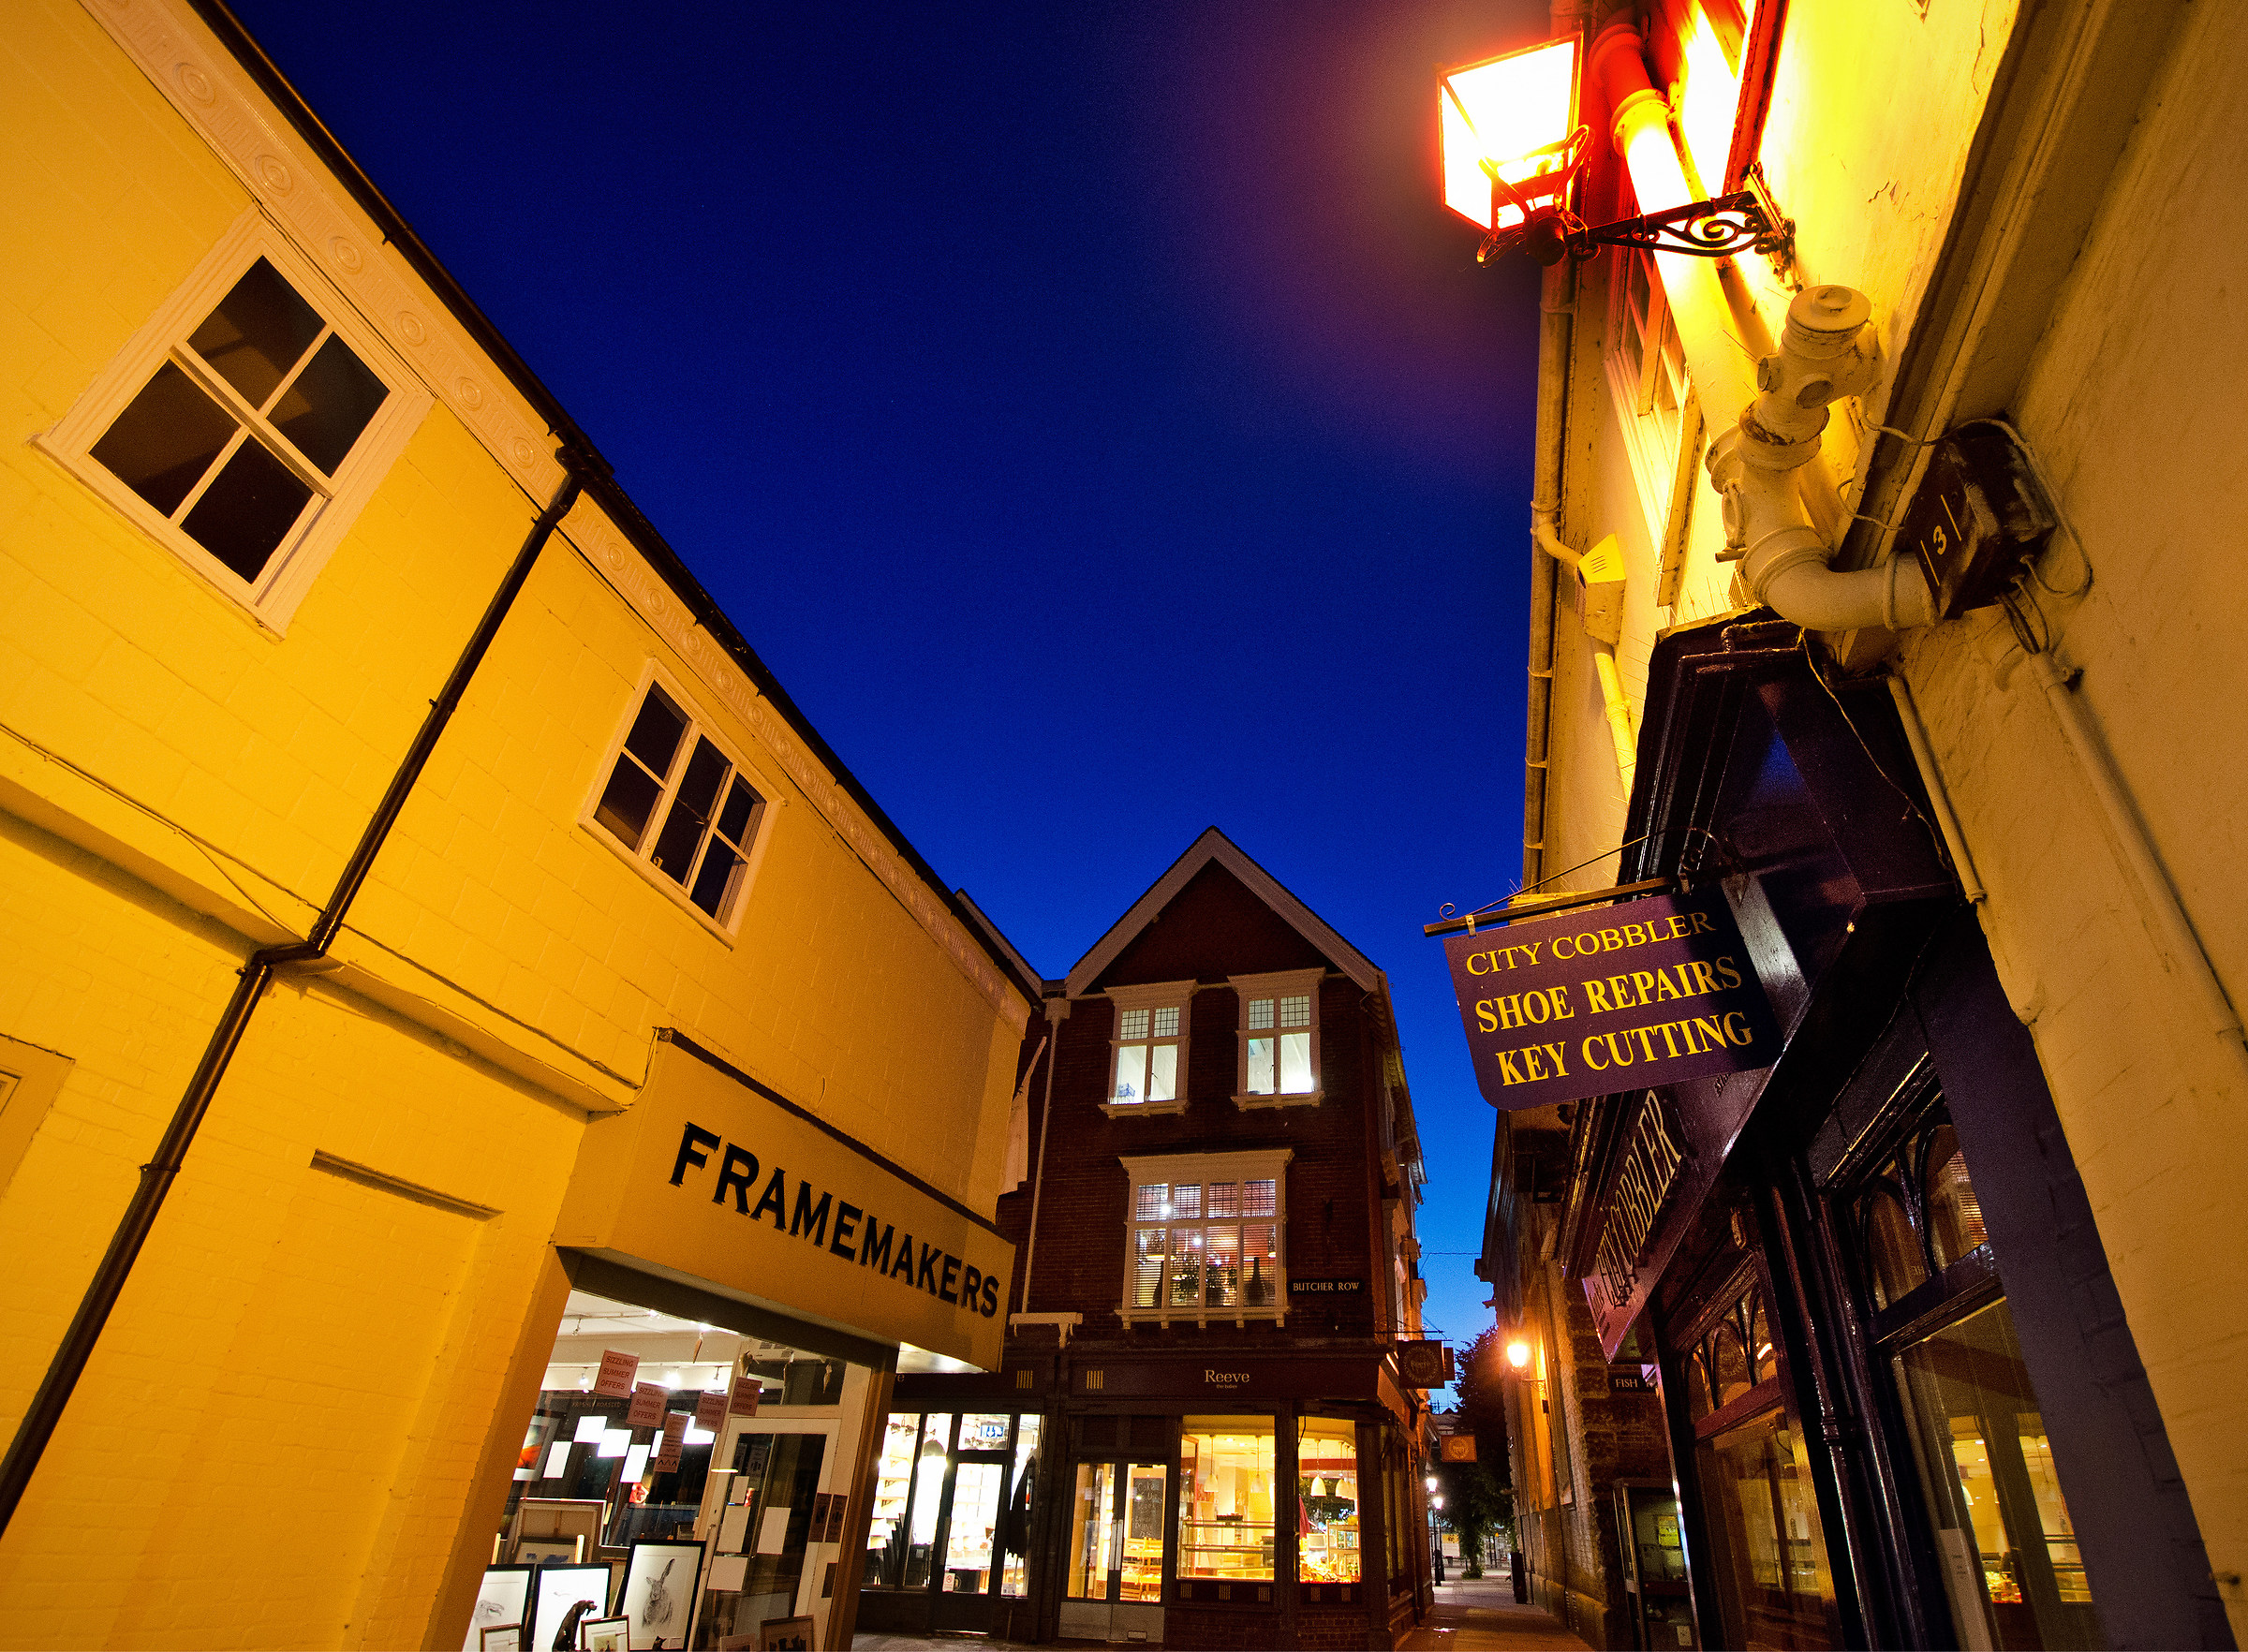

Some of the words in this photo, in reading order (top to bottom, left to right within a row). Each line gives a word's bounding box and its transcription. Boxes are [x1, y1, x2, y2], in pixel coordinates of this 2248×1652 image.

[1932, 524, 1947, 555] 3
[1466, 941, 1543, 976] CITY
[1551, 911, 1717, 960] COBBLER
[1475, 985, 1575, 1033] SHOE
[1581, 955, 1742, 1014] REPAIRS
[1495, 1040, 1570, 1086] KEY
[1582, 1010, 1753, 1070] CUTTING
[1610, 1089, 1682, 1270] COBBLER
[668, 1121, 1000, 1318] FRAMEMAKERS
[1595, 1219, 1628, 1305] CITY
[1293, 1282, 1334, 1291] BUTCHER
[1338, 1281, 1360, 1291] ROW
[605, 1355, 634, 1367] SIZZLING
[603, 1367, 630, 1379] SUMMER
[1205, 1369, 1250, 1383] Reeve
[600, 1379, 626, 1390] OFFERS
[1615, 1379, 1638, 1388] FISH
[638, 1387, 664, 1397] SIZZLING
[636, 1398, 661, 1409] SUMMER
[633, 1409, 657, 1420] OFFERS
